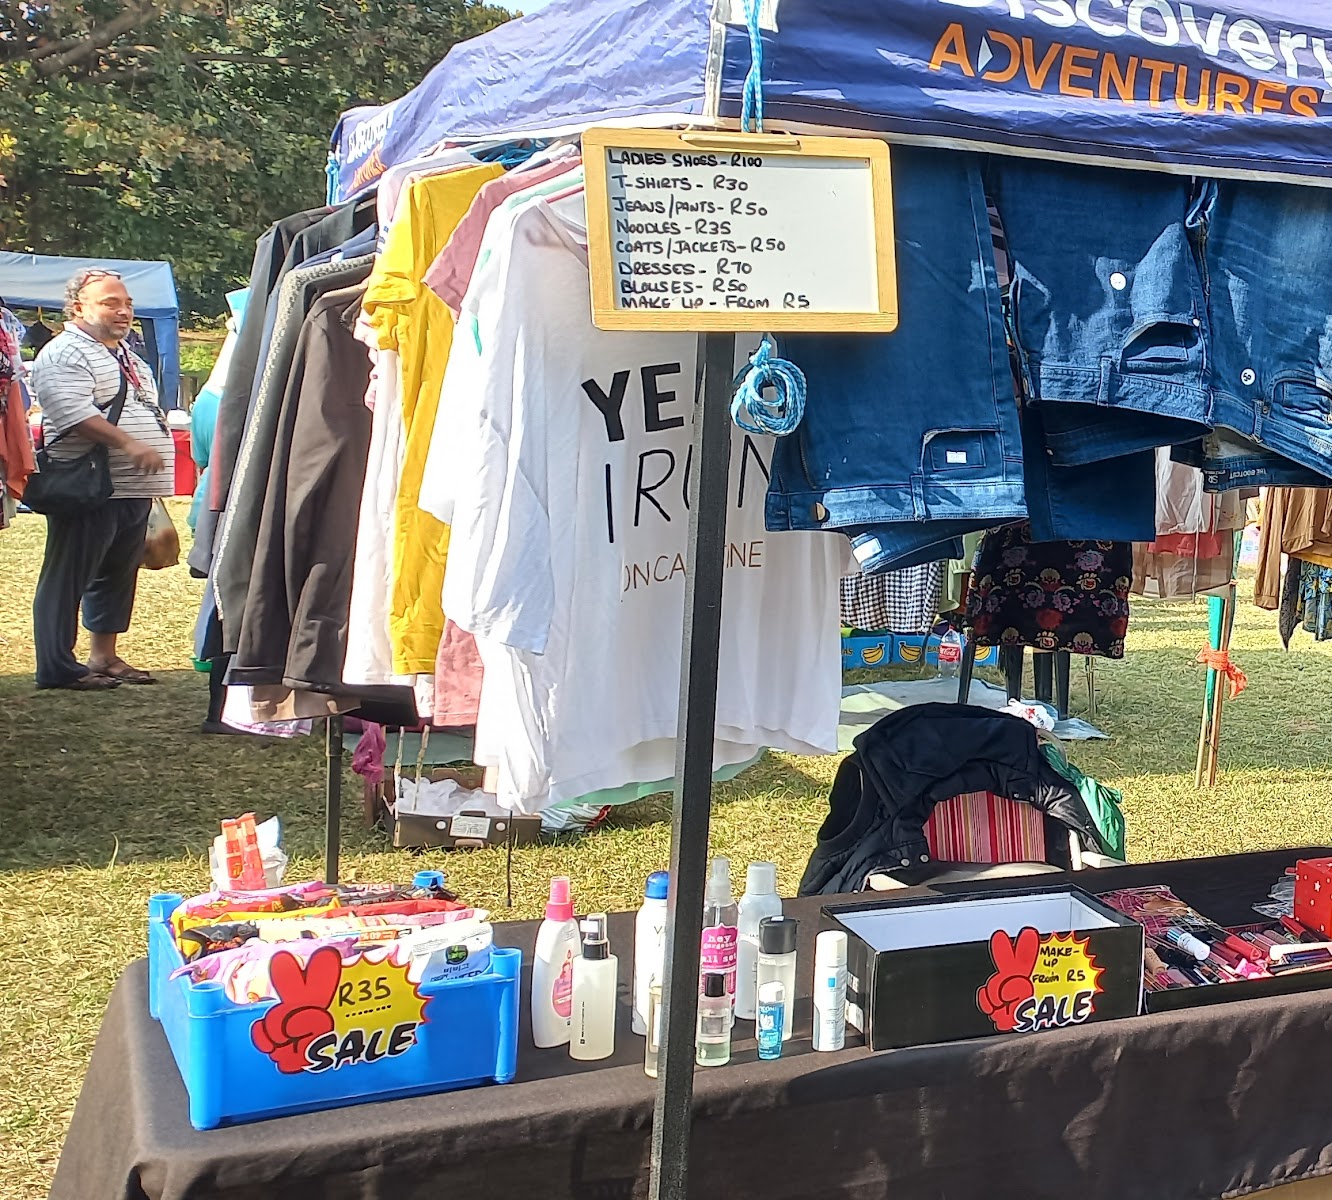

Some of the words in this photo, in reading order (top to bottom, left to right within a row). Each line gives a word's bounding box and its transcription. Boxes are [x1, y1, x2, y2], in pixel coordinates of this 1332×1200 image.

[928, 22, 1320, 118] ADVENTURES
[607, 148, 667, 166] LADIES
[713, 174, 749, 191] R30
[730, 198, 768, 217] R50
[750, 237, 786, 252] R50
[716, 257, 753, 275] R70
[712, 277, 748, 293] R50
[621, 296, 671, 309] MAKE
[681, 296, 704, 309] UP
[725, 295, 769, 309] FROM
[783, 292, 810, 309] R5
[605, 434, 770, 544] IRN
[708, 934, 732, 944] hey
[1043, 958, 1058, 968] UP
[1066, 969, 1086, 982] R5
[338, 976, 392, 1008] R35
[1013, 991, 1093, 1031] SALE
[305, 1022, 418, 1072] SALE
